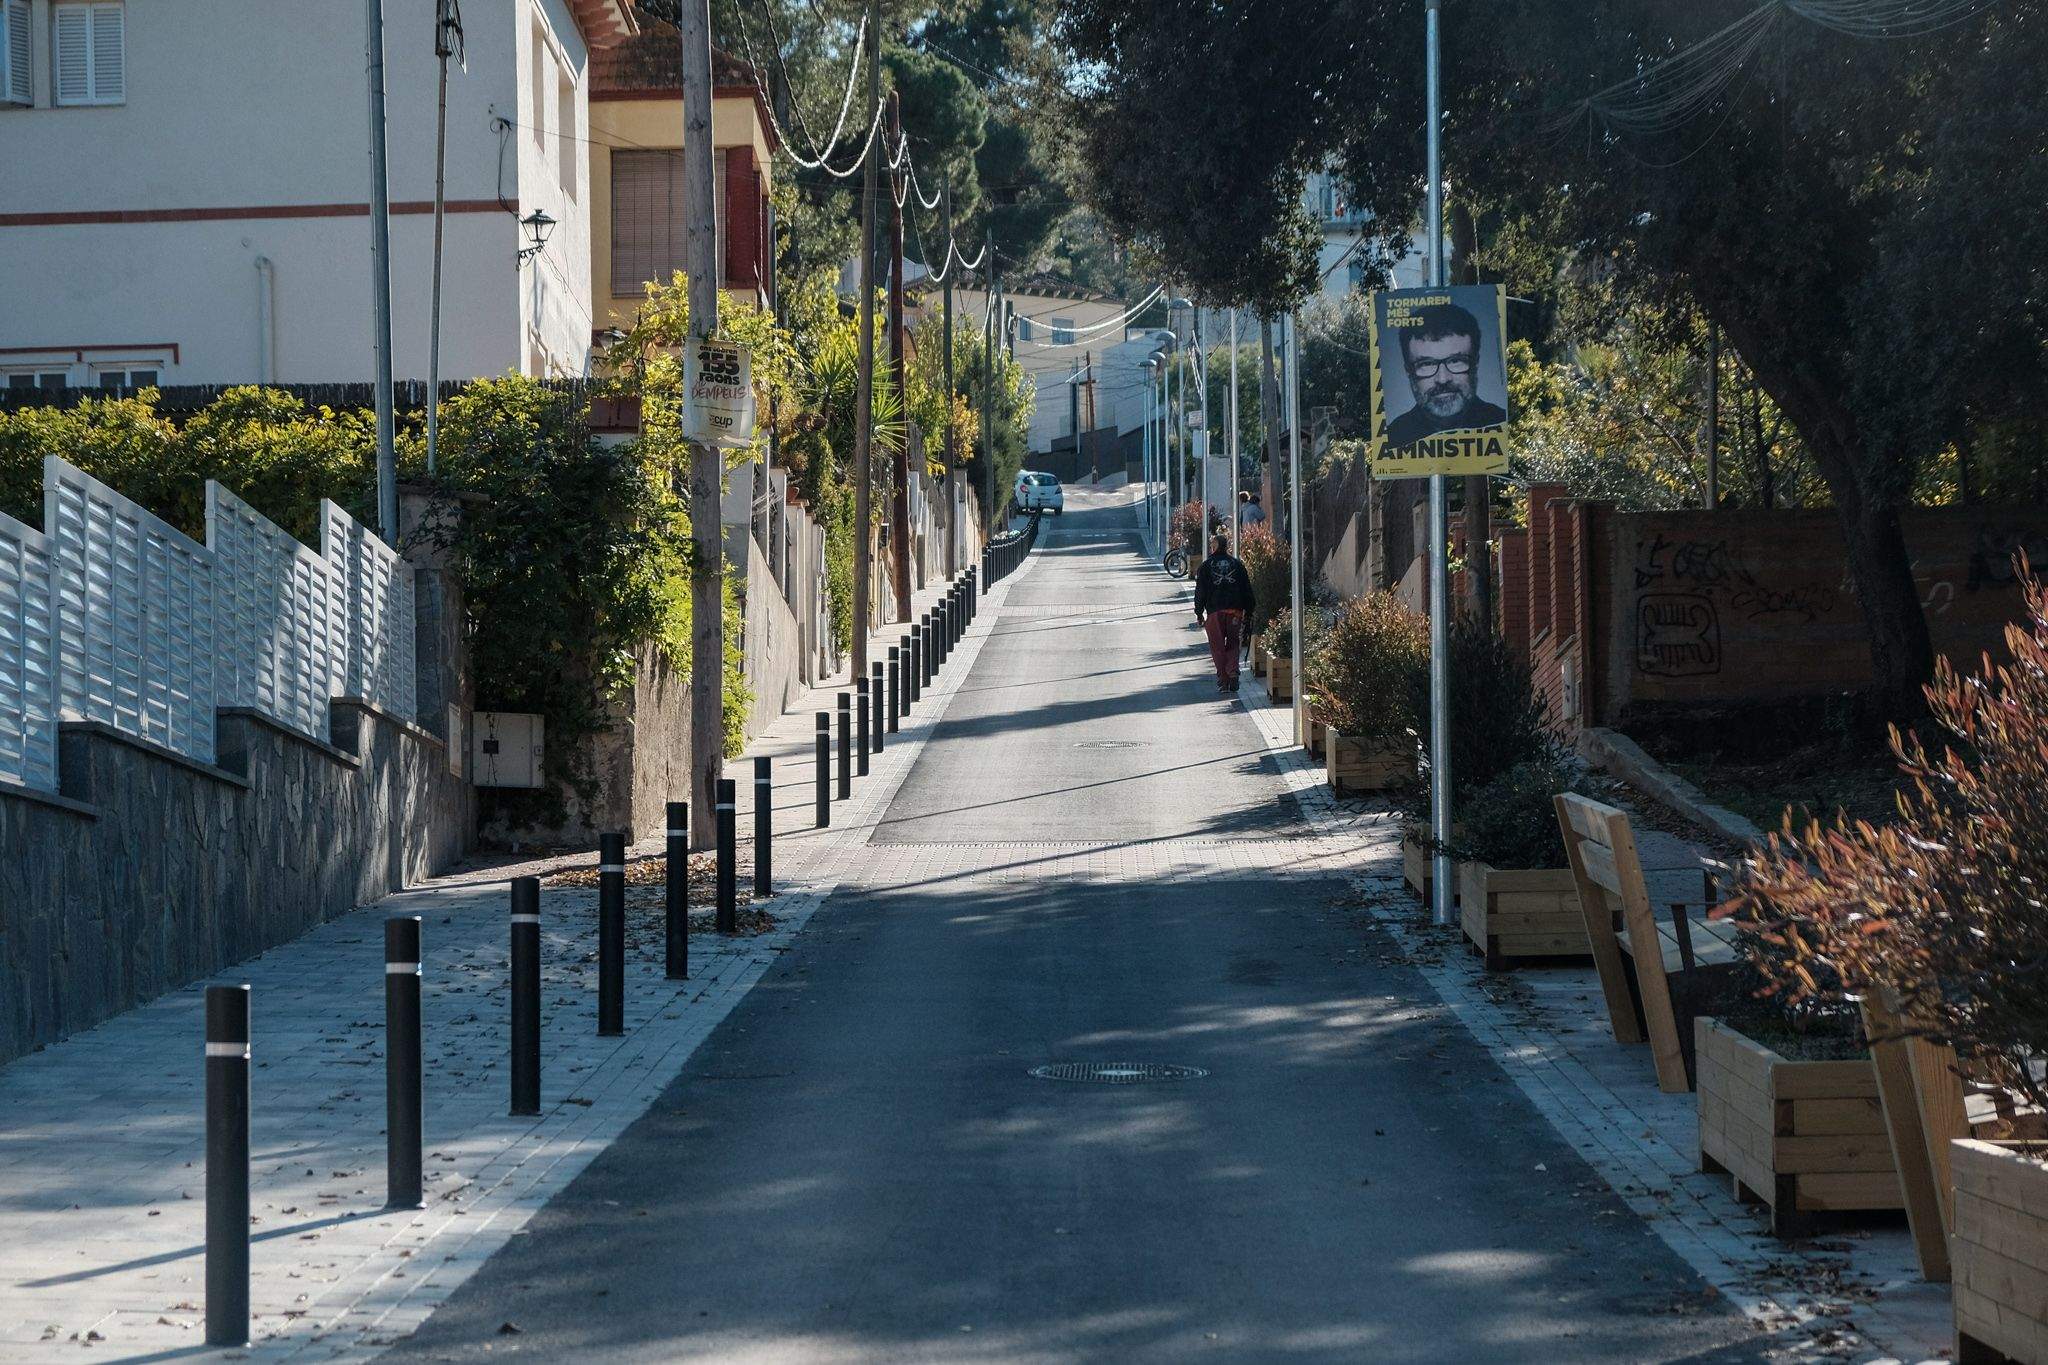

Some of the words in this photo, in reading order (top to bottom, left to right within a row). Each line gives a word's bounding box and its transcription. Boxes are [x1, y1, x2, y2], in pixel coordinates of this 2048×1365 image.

[1387, 296, 1451, 308] TORNAREM
[1387, 317, 1424, 328] FORTS
[698, 352, 740, 375] 155
[699, 372, 740, 385] raons
[714, 415, 733, 428] cup
[1377, 437, 1503, 460] AMNISTIA
